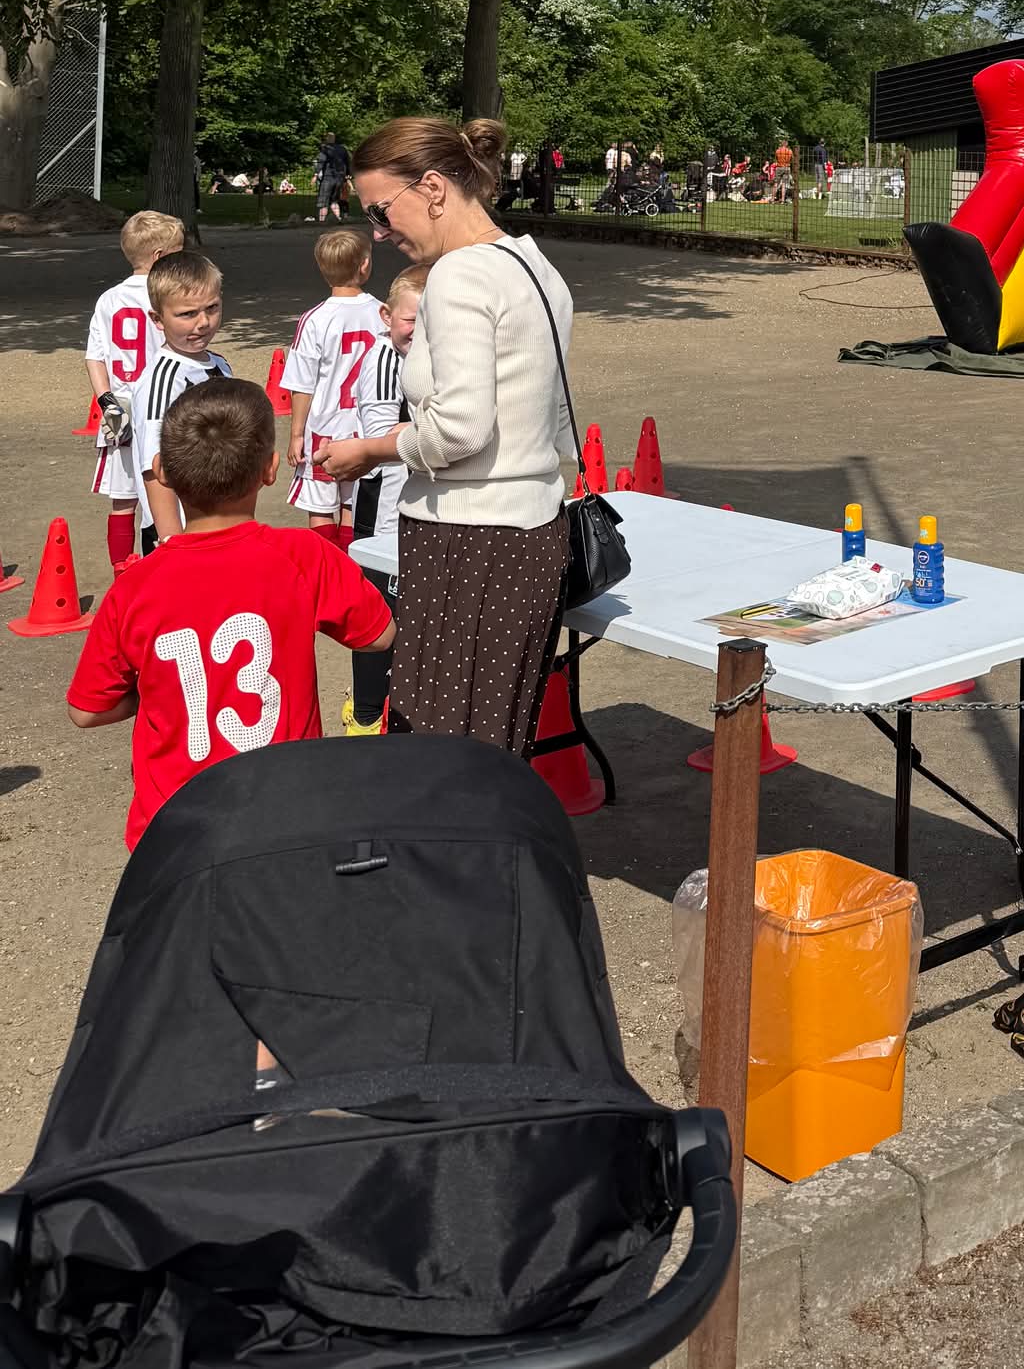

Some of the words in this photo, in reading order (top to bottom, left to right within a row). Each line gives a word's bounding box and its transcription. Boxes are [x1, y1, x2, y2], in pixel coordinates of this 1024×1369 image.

[111, 307, 147, 382] 9
[340, 330, 376, 410] 2
[154, 612, 281, 762] 13
